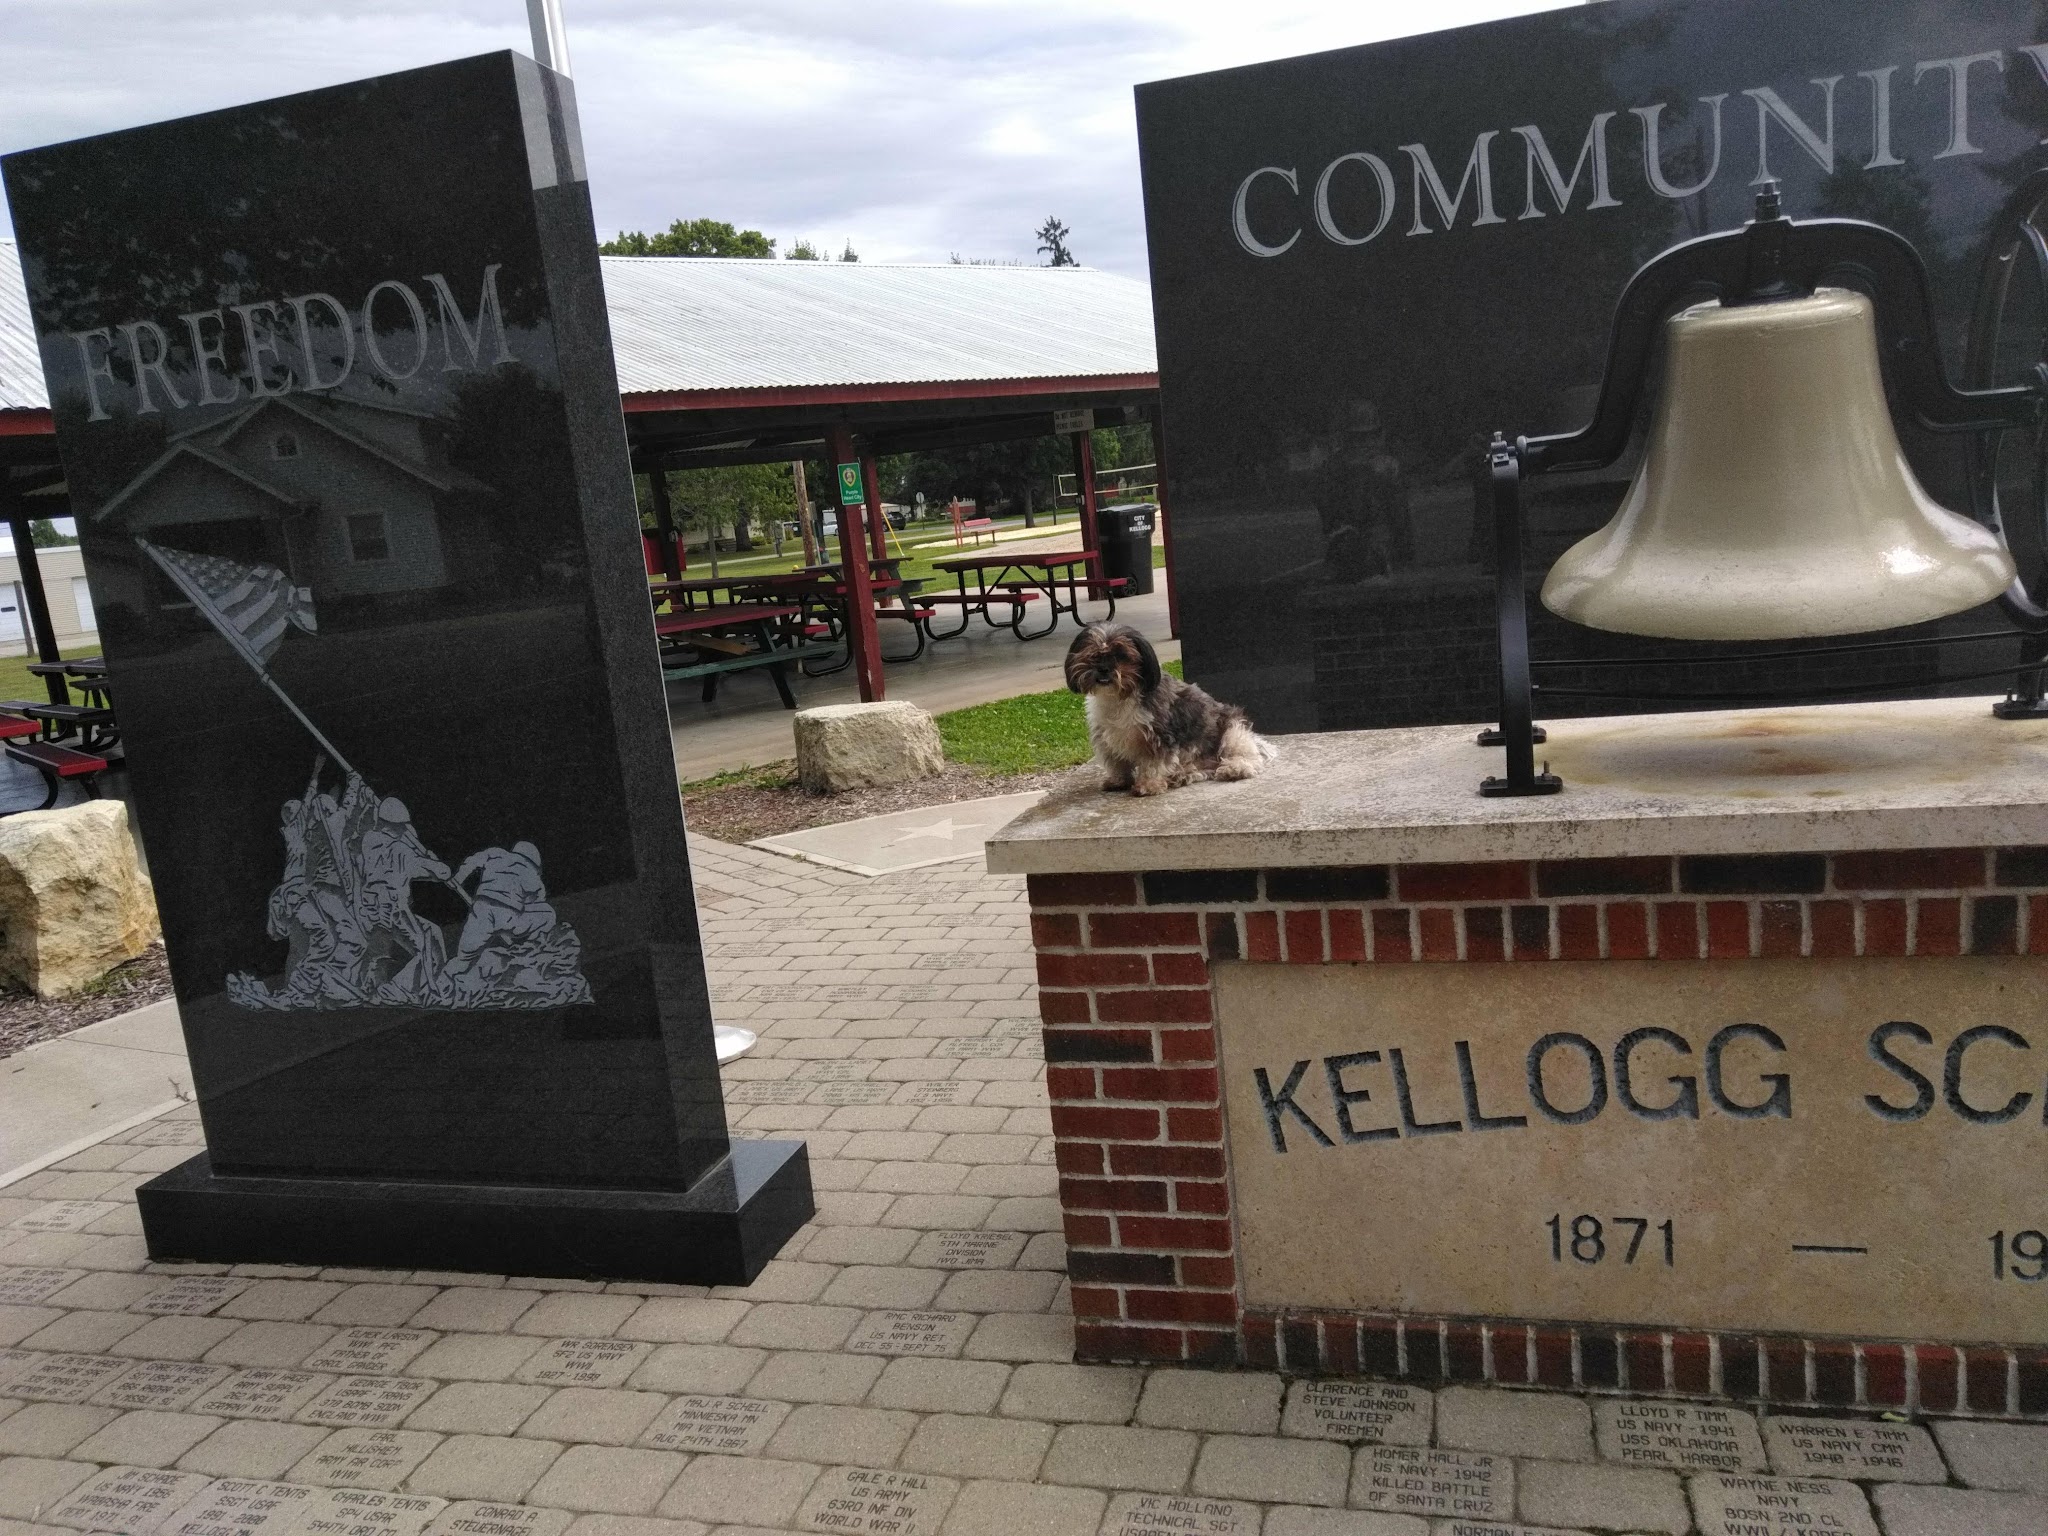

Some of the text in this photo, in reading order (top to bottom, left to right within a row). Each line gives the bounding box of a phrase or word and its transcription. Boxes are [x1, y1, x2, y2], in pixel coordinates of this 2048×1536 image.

[69, 263, 521, 422] FREEDOM
[1254, 1021, 2048, 1154] KELLOGG SC
[938, 1232, 1014, 1241] FLOYD KRIESEL
[1545, 1213, 1675, 1267] 1871
[911, 1313, 956, 1322] RICHARD
[892, 1322, 937, 1331] BENSON
[870, 1331, 946, 1342] US NAVY RET
[561, 1340, 637, 1351] WR SORENSEN
[854, 1341, 876, 1349] DEC
[902, 1343, 928, 1351] SEPT
[330, 1349, 371, 1359] FATHER
[577, 1351, 593, 1359] US
[594, 1352, 625, 1361] NAVY
[232, 1381, 263, 1390] ARMY
[349, 1379, 392, 1389] GEORGE
[1306, 1383, 1408, 1399] CLARENCE AND
[378, 1391, 413, 1401] TRANS
[1303, 1394, 1416, 1412] STEVE JOHNSON
[342, 1400, 373, 1410] BOMB
[684, 1399, 769, 1413] MAJ R SCHELL
[308, 1410, 358, 1420] ENGLAND
[679, 1410, 760, 1424] MINNIESKA MN
[1315, 1408, 1394, 1424] VOLUNTEER
[1620, 1405, 1728, 1422] LLOYD R TIMM
[673, 1422, 747, 1435] MIA VIETNAM
[1327, 1423, 1384, 1437] FIREMEN
[1617, 1419, 1738, 1437] US NAVY 1941
[1777, 1424, 1910, 1442] WARREN E TIMM
[369, 1432, 398, 1442] EARL
[651, 1433, 748, 1449] AUG 24TH 1967
[1620, 1433, 1739, 1452] USS OKLAHOMA
[1791, 1438, 1905, 1454] US NAVY CMM
[314, 1455, 348, 1465] ARMY
[347, 1457, 370, 1467] AIR
[1373, 1448, 1493, 1468] HOMER HALL JR
[1622, 1448, 1742, 1467] PEARL HARBOR
[117, 1469, 140, 1480] JIM
[1373, 1462, 1492, 1482] US NAVY 1942
[94, 1480, 113, 1491] US
[113, 1483, 145, 1495] NAVY
[847, 1471, 928, 1490] GALE R HILL
[1372, 1476, 1491, 1497] KILLED BATTLE
[1720, 1477, 1832, 1495] WAYNE NESS
[217, 1481, 310, 1499] SCOTT C TENTIS
[851, 1486, 910, 1501] US ARMY
[131, 1501, 160, 1513] FIRE
[215, 1496, 282, 1511] SSGT USAF
[331, 1491, 430, 1512] CHARLES TENTIS
[1140, 1497, 1233, 1517] VIC HOLLAND
[1369, 1491, 1493, 1513] OF SANTA CRUZ
[1756, 1494, 1800, 1507] NAVY
[336, 1508, 397, 1523] SP4 USAR
[475, 1506, 538, 1522] CONRAD A
[828, 1499, 917, 1518] 63RD INF DIV
[1725, 1507, 1770, 1521] BOSN
[1778, 1511, 1812, 1525] 2ND
[307, 1520, 349, 1534] 544TH
[814, 1513, 862, 1528] WORLD
[869, 1519, 900, 1533] WAR
[1126, 1511, 1201, 1529] TECHNICAL
[1209, 1520, 1239, 1532] SGT
[1723, 1521, 1769, 1536] WWII
